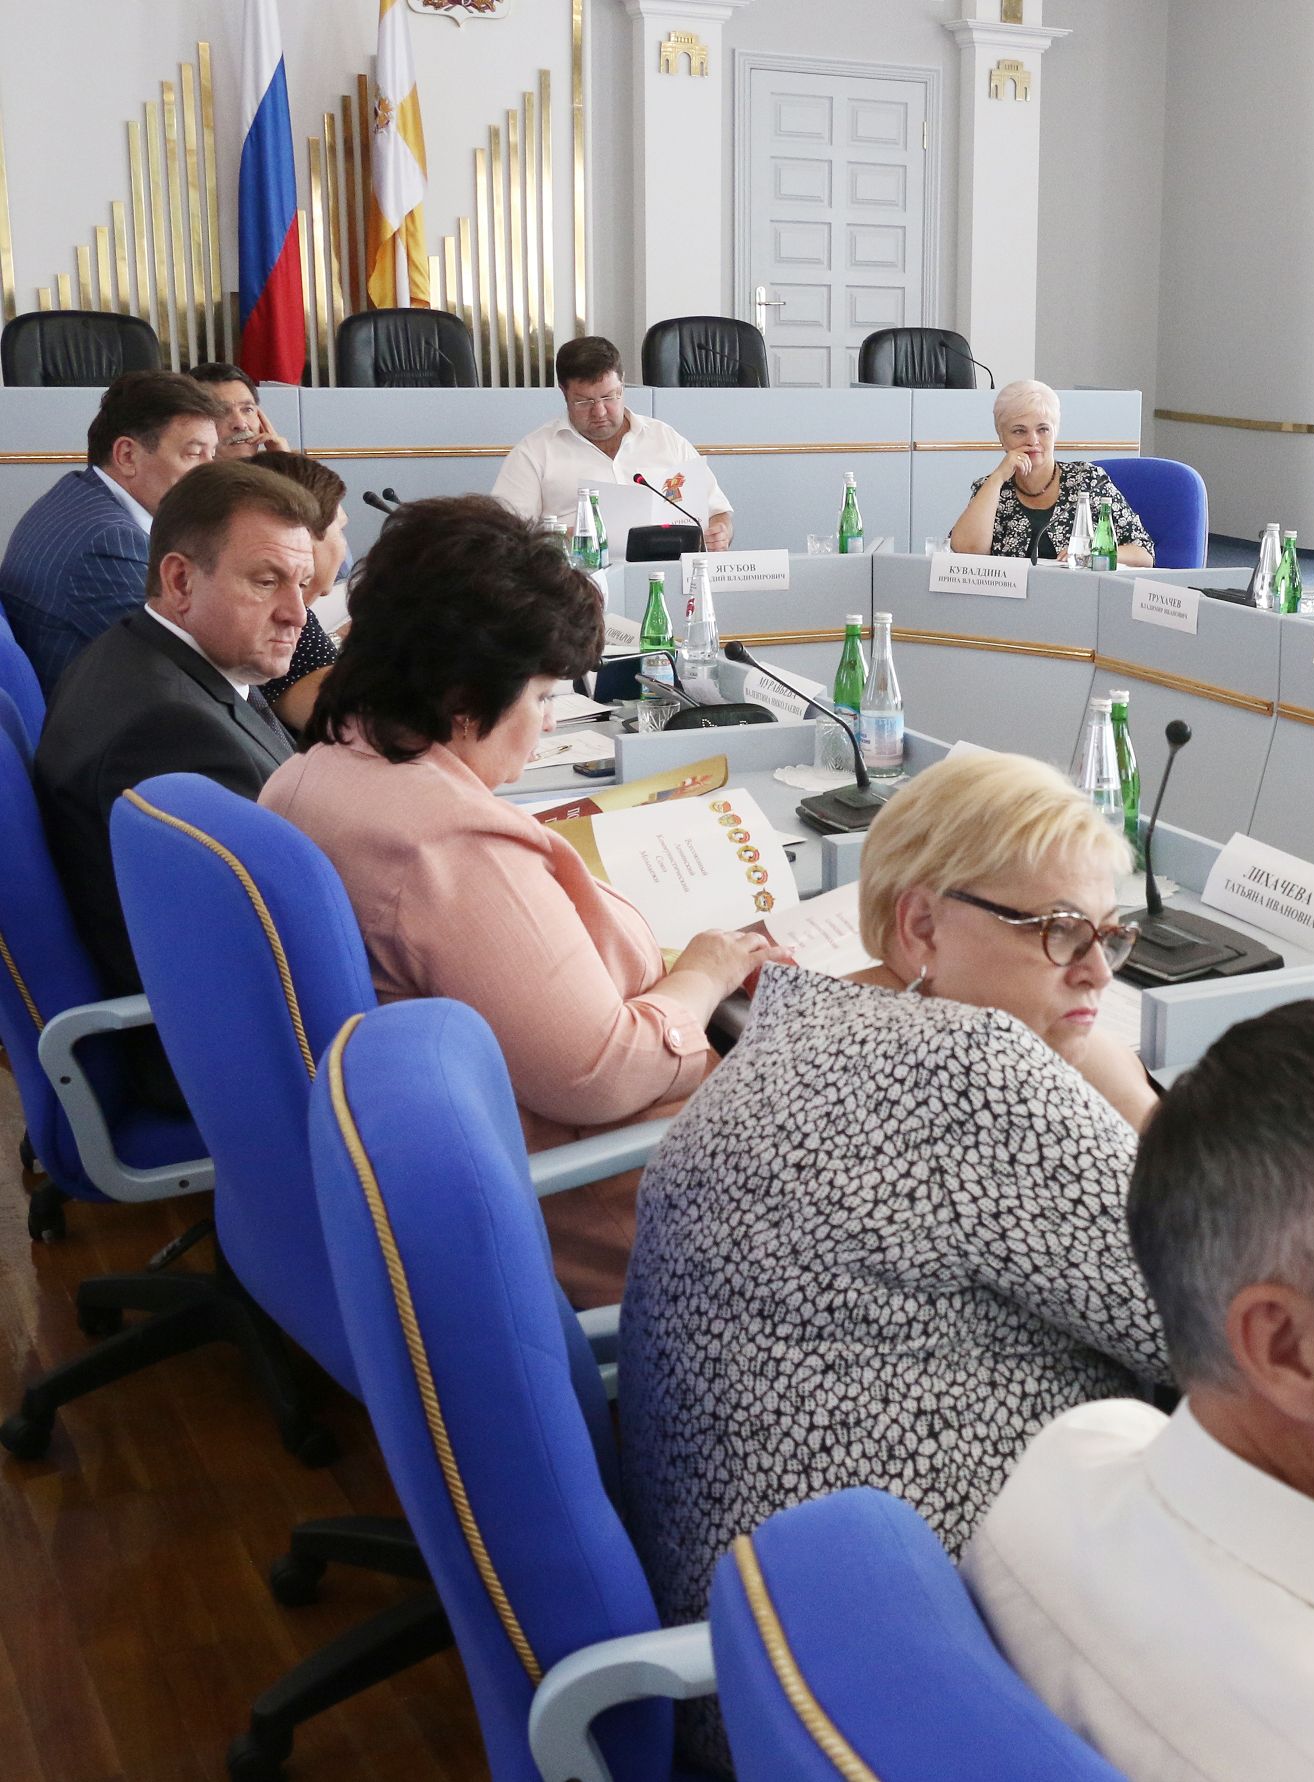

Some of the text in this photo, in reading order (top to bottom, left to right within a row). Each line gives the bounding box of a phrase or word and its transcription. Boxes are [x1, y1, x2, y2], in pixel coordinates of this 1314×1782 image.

[716, 563, 757, 573] ЯГУБОВ
[949, 565, 1007, 579] КУВАЛДИНА
[727, 573, 786, 583] ВЛАДИМИРОВИЧ
[938, 575, 1017, 589] ИРИНА ВЛАДИМИРОВНА
[1148, 592, 1182, 609] ТРУХАЧЕВ
[1224, 878, 1264, 907] ТАТЬЯНА
[1242, 865, 1313, 906] ЛИХАЧЕВА
